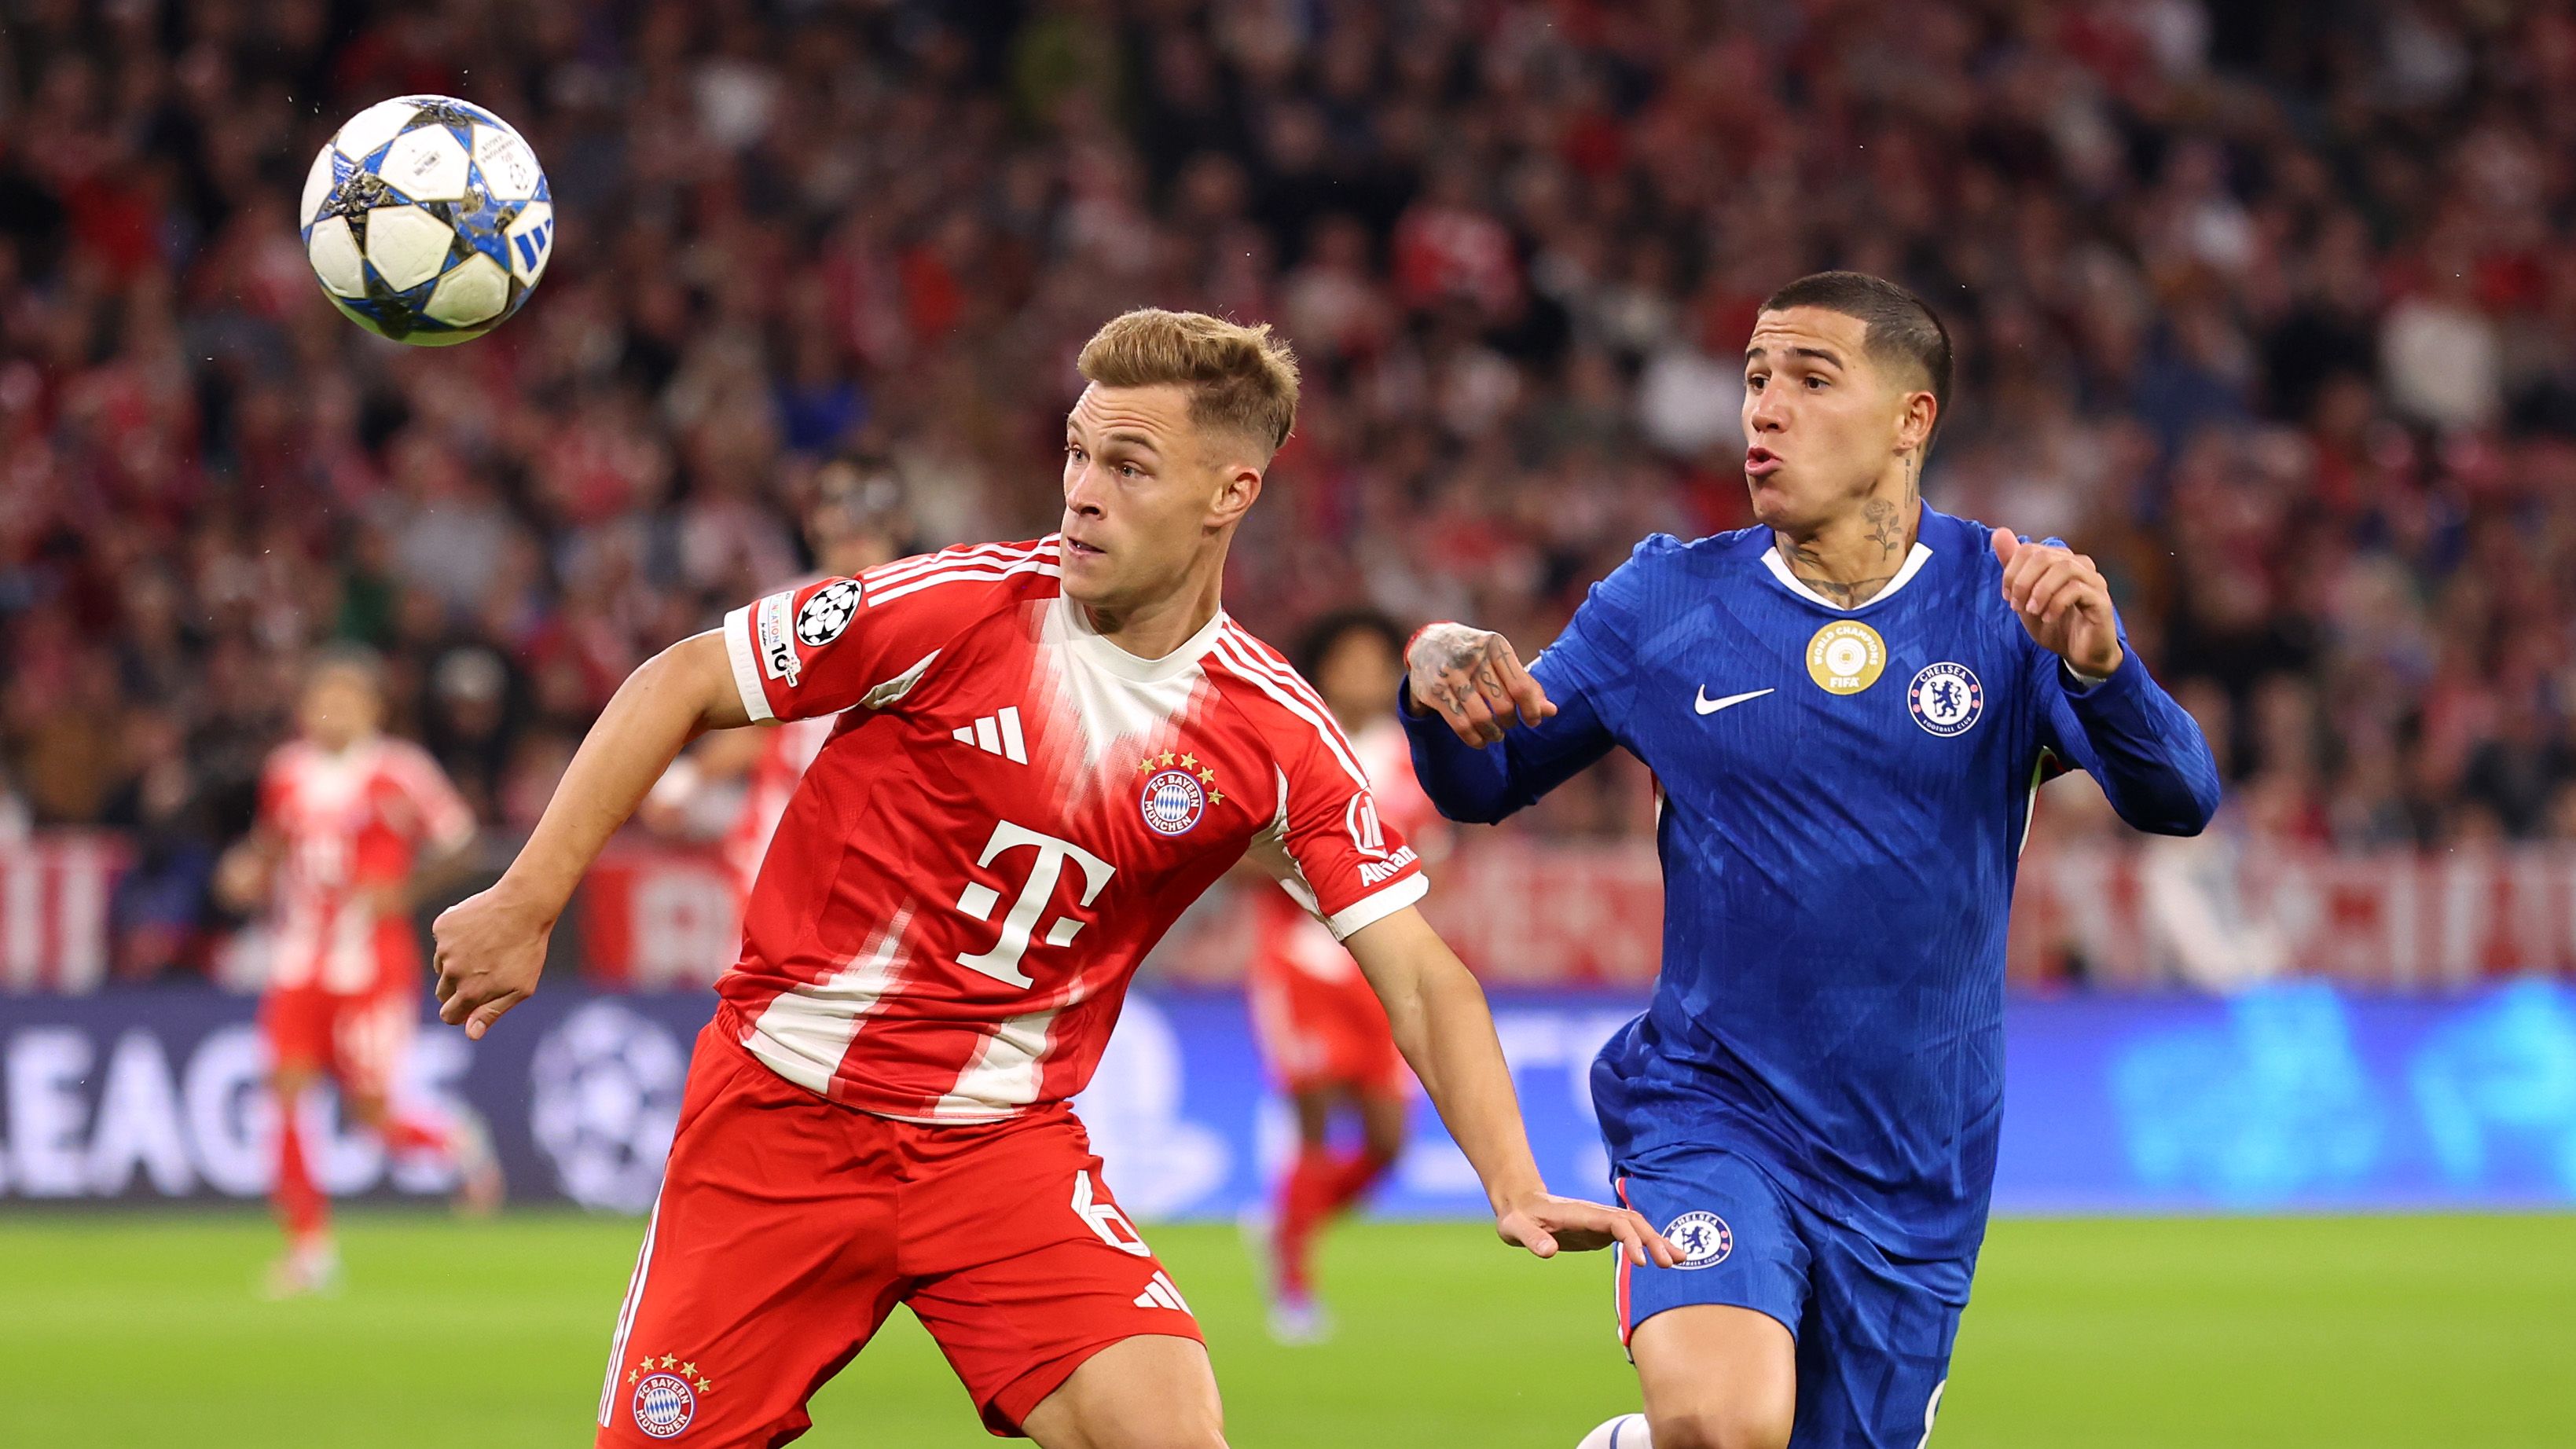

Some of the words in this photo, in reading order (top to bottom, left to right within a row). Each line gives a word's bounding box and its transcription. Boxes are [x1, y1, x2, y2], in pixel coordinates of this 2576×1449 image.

[772, 643, 788, 672] 10
[1814, 631, 1835, 666] WORLD
[1836, 626, 1879, 666] CHAMPIONS
[1829, 677, 1859, 688] FIFA
[1919, 666, 1966, 683] CHELSEA
[1923, 719, 1955, 732] FOOTBALL
[1957, 716, 1972, 729] CLUB
[1150, 777, 1165, 792] FC
[1168, 775, 1199, 808] BAYERN
[0, 1028, 473, 1197] EAGUE
[1070, 1169, 1151, 1257] 6
[1671, 1213, 1718, 1231] CHELSEA
[638, 1384, 651, 1399] FC
[651, 1378, 690, 1405] BAYERN
